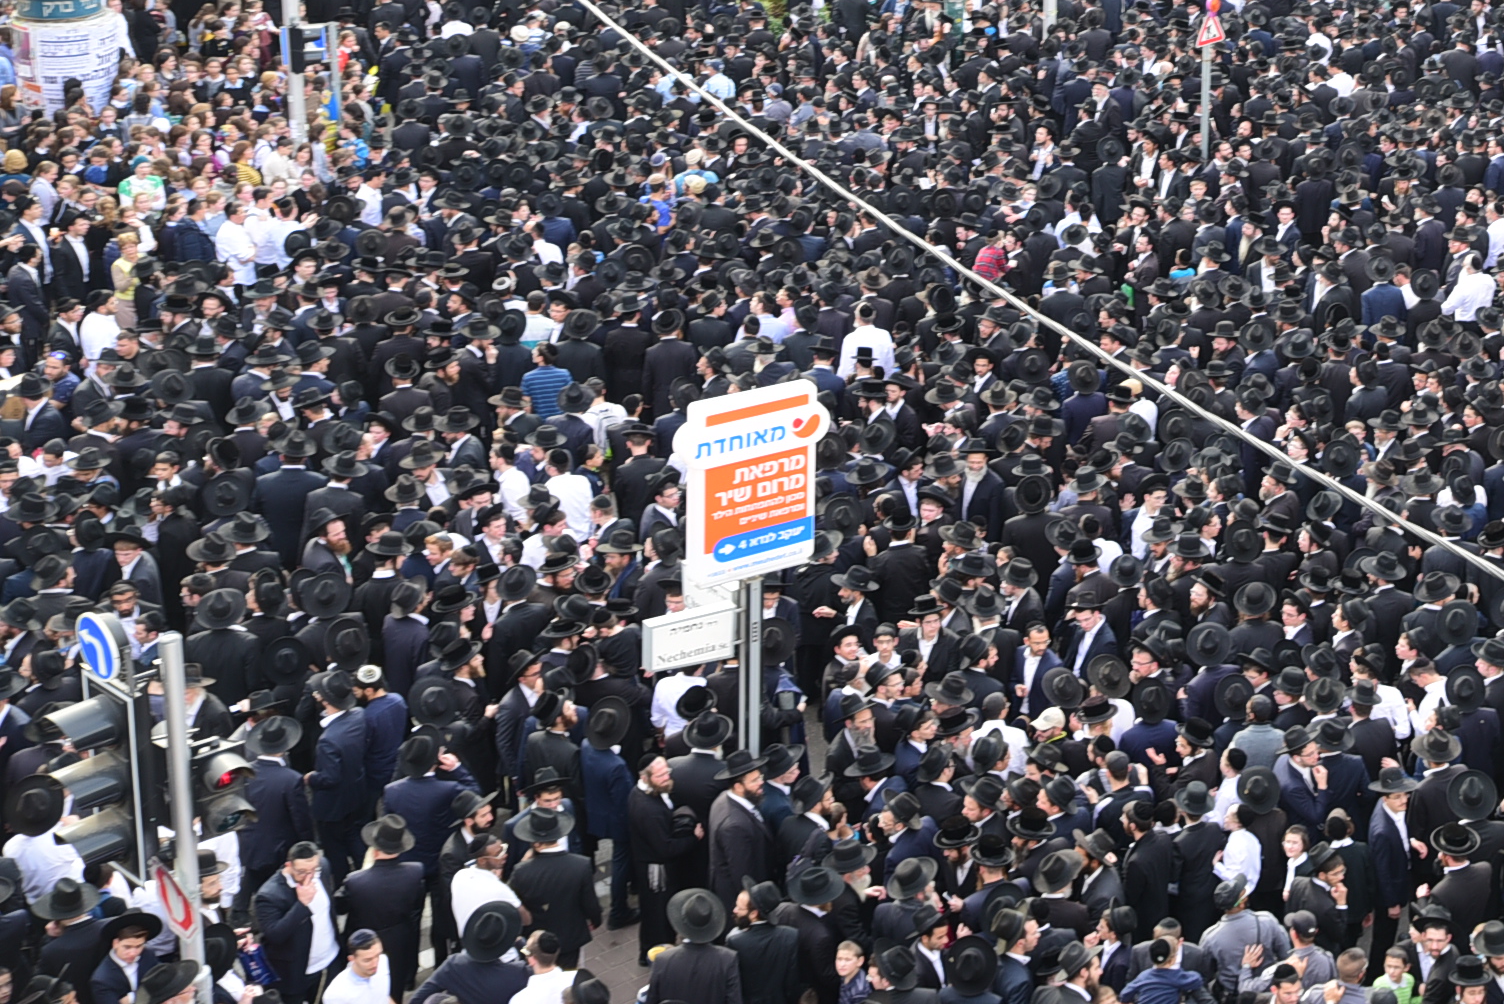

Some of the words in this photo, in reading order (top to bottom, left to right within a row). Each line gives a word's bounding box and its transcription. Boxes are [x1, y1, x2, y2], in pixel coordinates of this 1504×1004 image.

[41, 0, 75, 17] ברק
[695, 425, 786, 459] מאוחדת
[732, 454, 806, 484] מרפאת
[714, 485, 752, 507] שיר
[756, 473, 806, 498] מרום
[785, 492, 805, 504] מכון
[738, 539, 747, 549] 4
[656, 642, 716, 666] Nechemia
